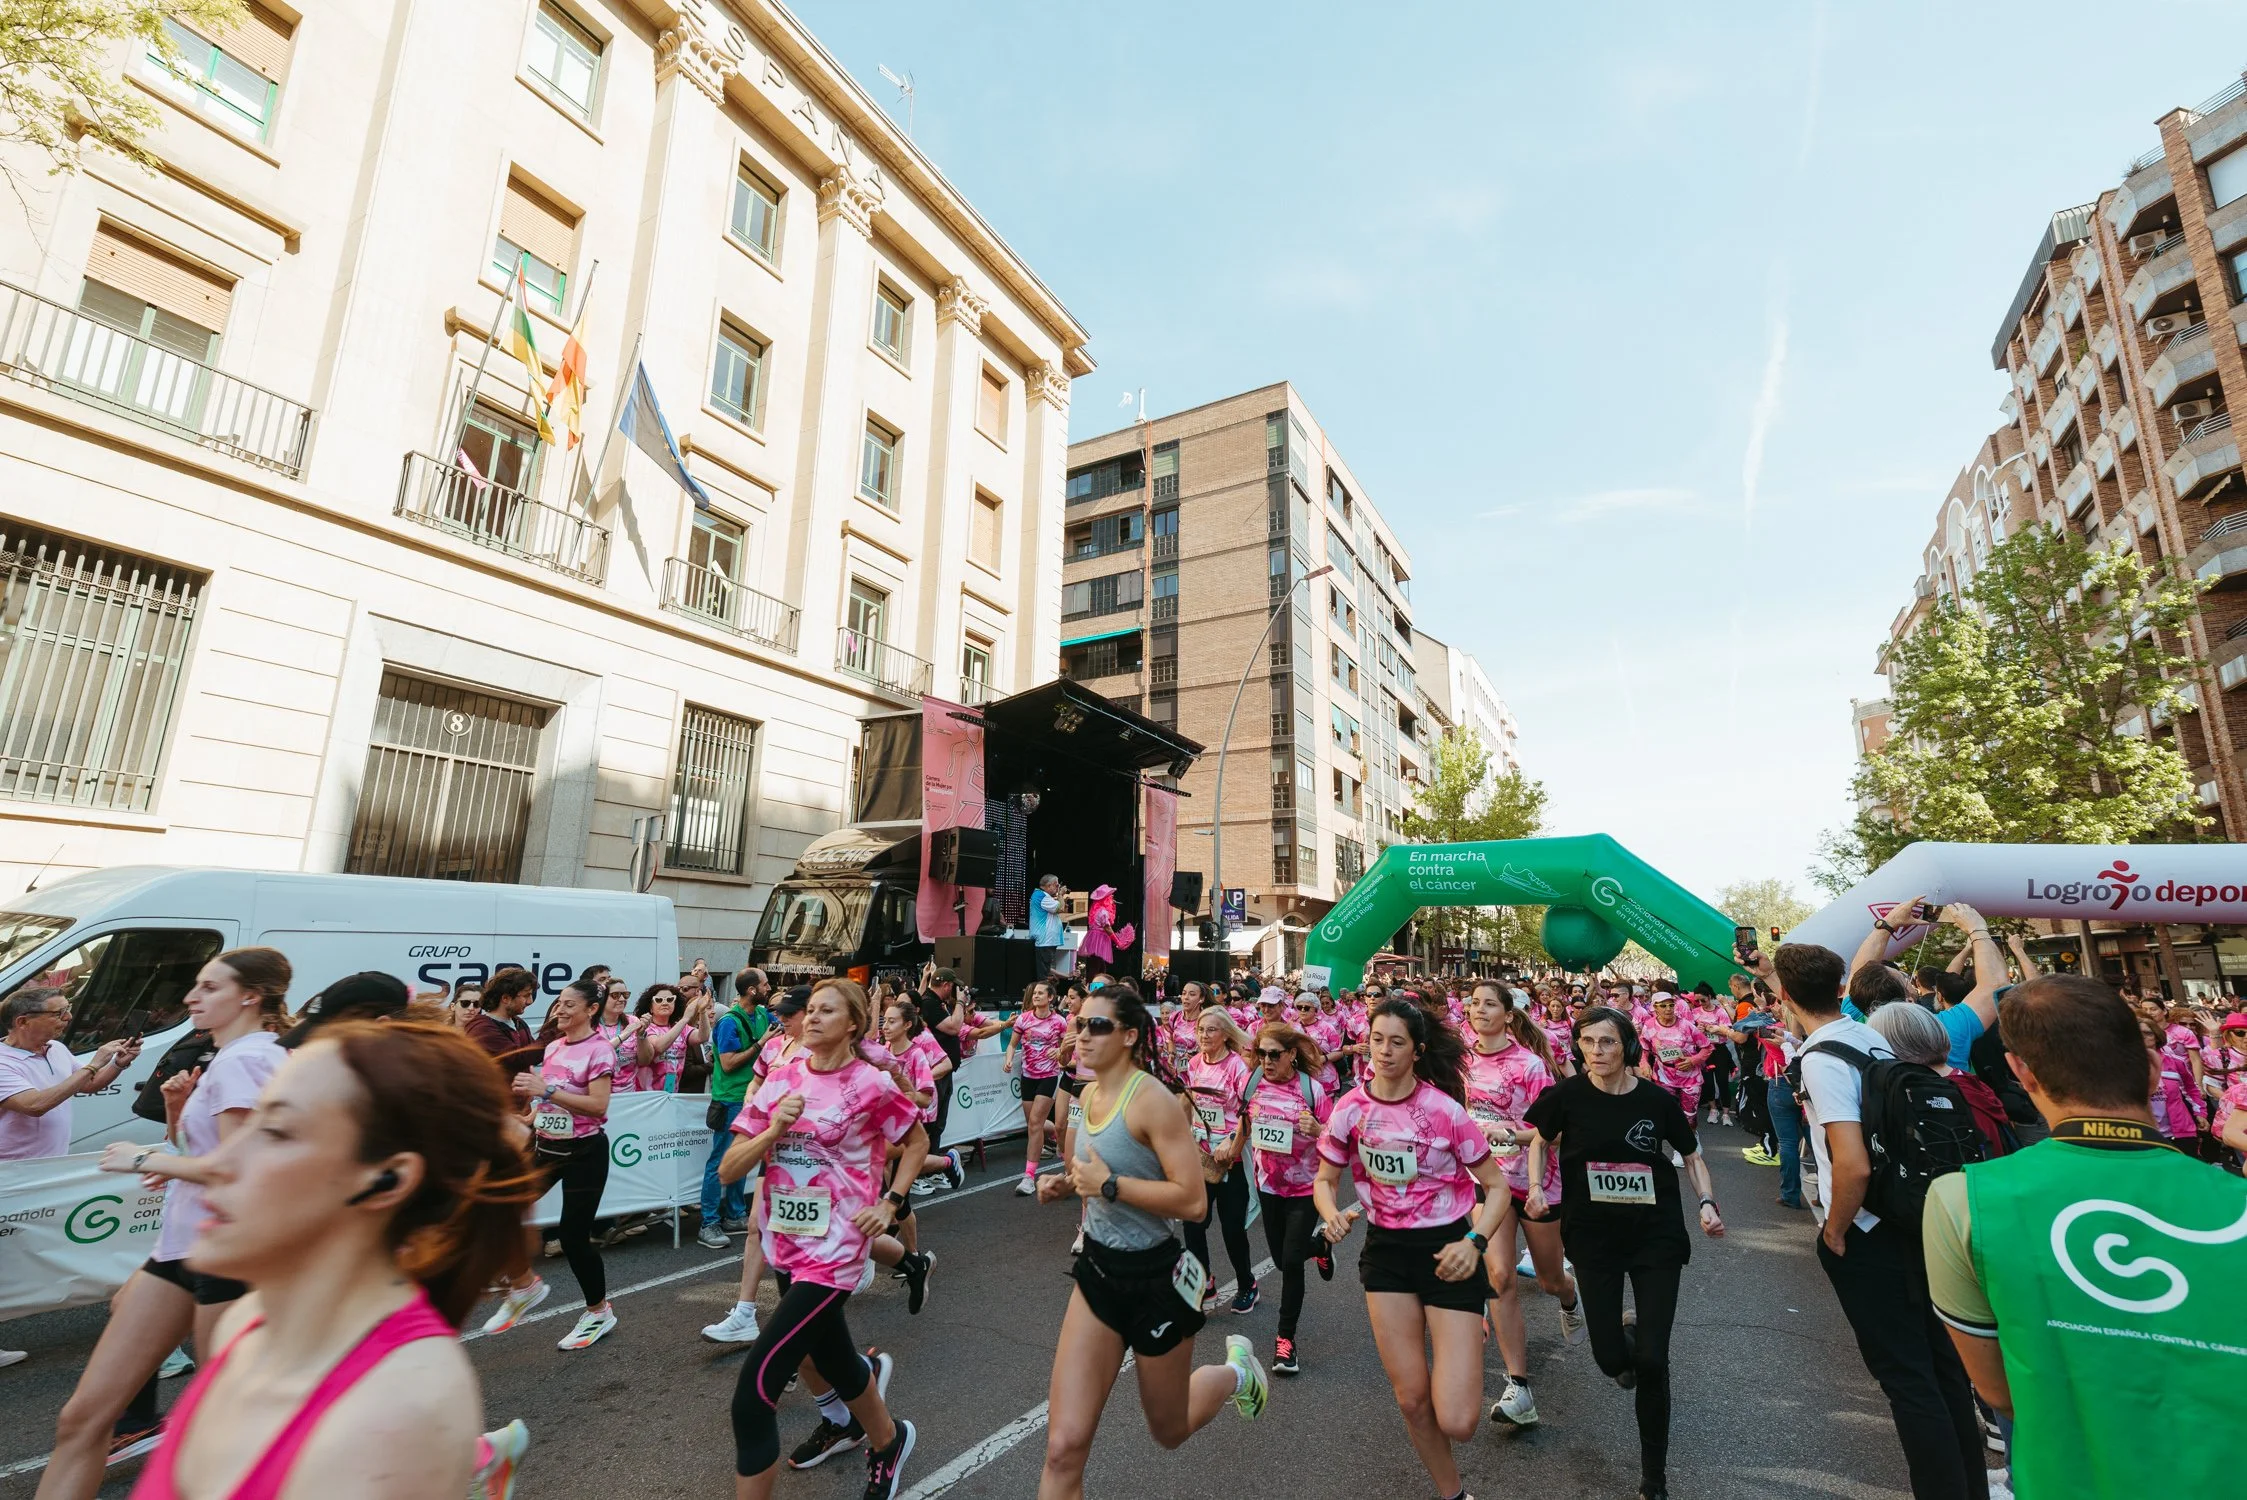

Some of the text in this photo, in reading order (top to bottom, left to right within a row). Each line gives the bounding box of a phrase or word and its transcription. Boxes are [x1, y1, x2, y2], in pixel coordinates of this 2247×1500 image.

[450, 714, 464, 733] 8
[1410, 850, 1485, 862] En marcha
[1408, 863, 1455, 876] contra
[1409, 877, 1477, 890] el cáncer
[1233, 891, 1244, 907] P
[1341, 907, 1357, 923] contra
[1345, 902, 1375, 928] en La Rioja
[1615, 909, 1657, 945] en La Rioja
[1621, 904, 1645, 925] contra
[1652, 929, 1679, 951] cáncer
[1664, 928, 1699, 958] española
[408, 945, 472, 958] GRUPO
[417, 952, 573, 1003] saje
[1661, 1049, 1680, 1058] 5505
[540, 1116, 568, 1130] 3963
[1258, 1112, 1284, 1120] Carrera
[648, 1130, 690, 1141] asociación
[783, 1130, 813, 1140] arrera
[1258, 1127, 1285, 1144] 1252
[2083, 1121, 2143, 1139] Nikon
[648, 1138, 709, 1151] contra el cáncer
[775, 1142, 803, 1152] por la
[660, 1151, 671, 1160] La
[672, 1149, 691, 1158] Rioja
[1366, 1151, 1405, 1174] 7031
[1594, 1174, 1648, 1192] 10941
[137, 1194, 164, 1206] aso
[133, 1207, 161, 1219] con
[778, 1199, 819, 1222] 5285
[128, 1222, 148, 1234] en
[2046, 1319, 2102, 1334] ASOCIACIÓN
[2103, 1327, 2151, 1340] ESPAÑOLA
[2151, 1333, 2195, 1348] CONTRA
[2195, 1340, 2210, 1350] EL
